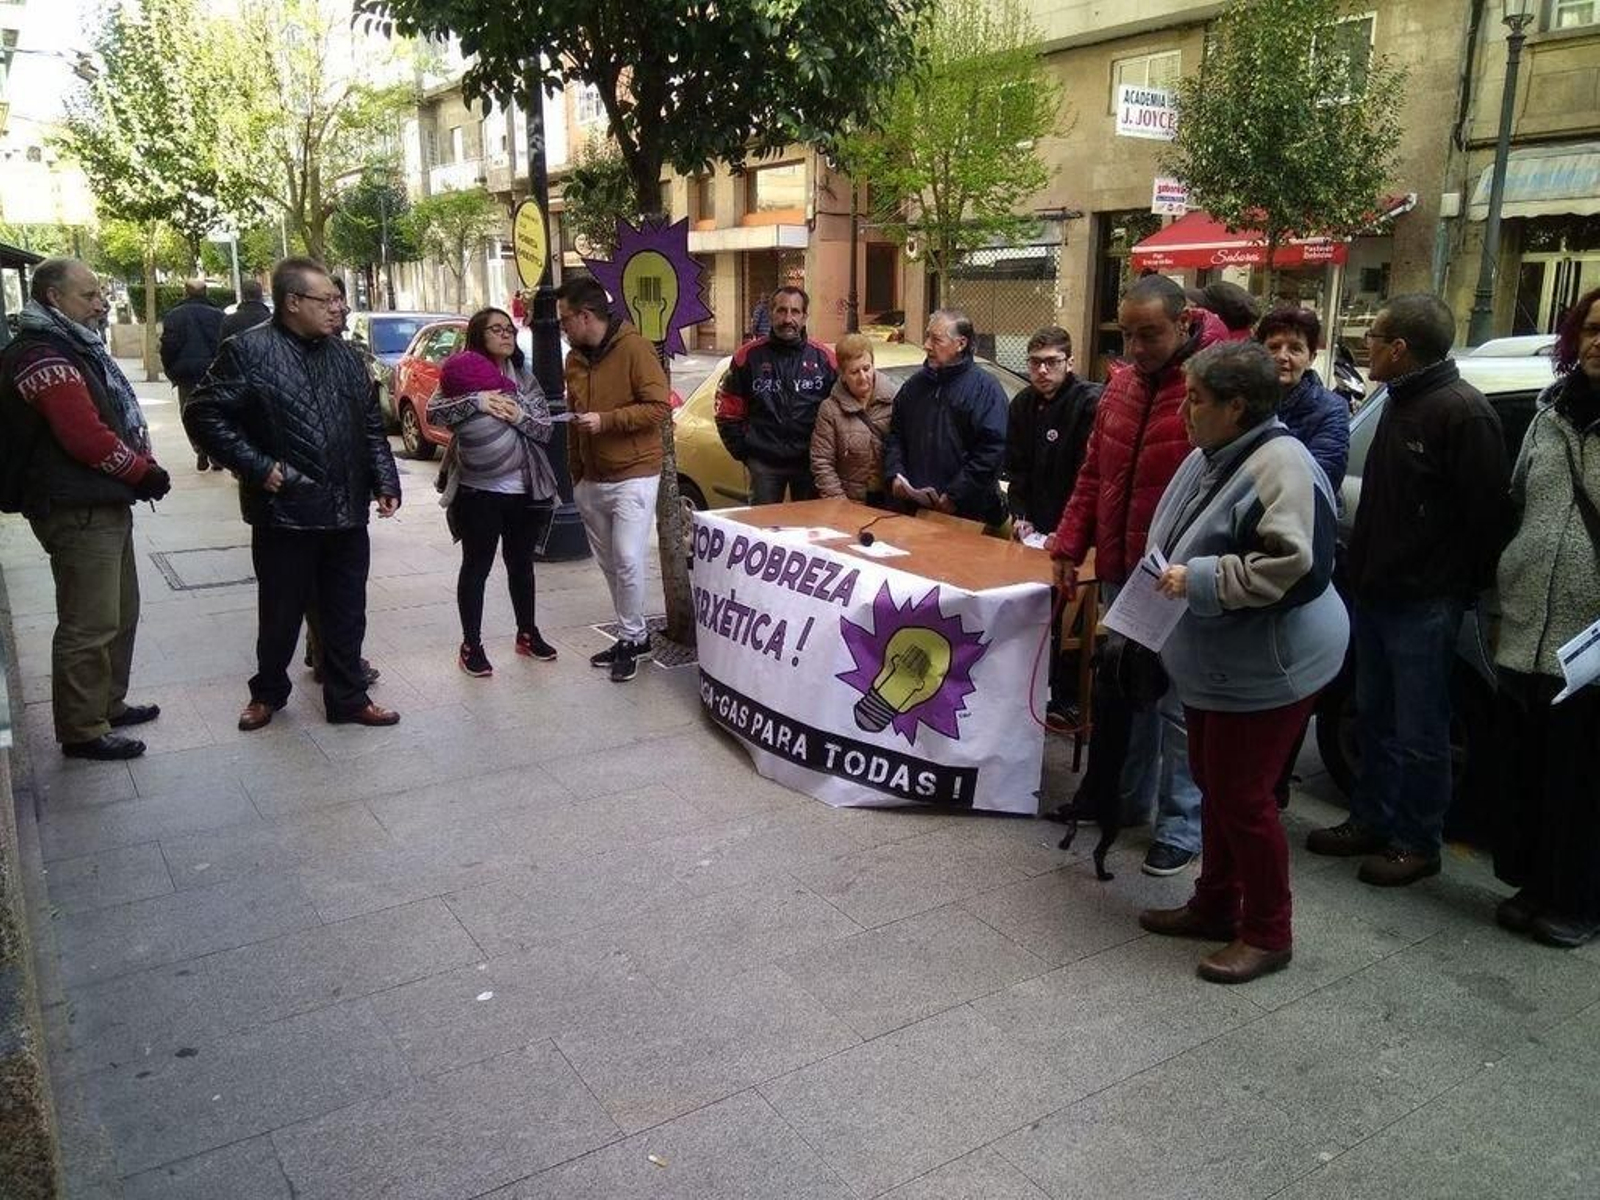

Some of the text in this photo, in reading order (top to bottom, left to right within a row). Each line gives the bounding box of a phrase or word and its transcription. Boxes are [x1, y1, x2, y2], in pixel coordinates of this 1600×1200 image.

[1121, 106, 1176, 129] J. JOYCE
[1122, 88, 1166, 108] ACADEMIA
[693, 523, 861, 608] TOP POBREZA
[750, 711, 807, 760] PARA
[824, 742, 937, 796] TODAS
[952, 775, 963, 799] !
